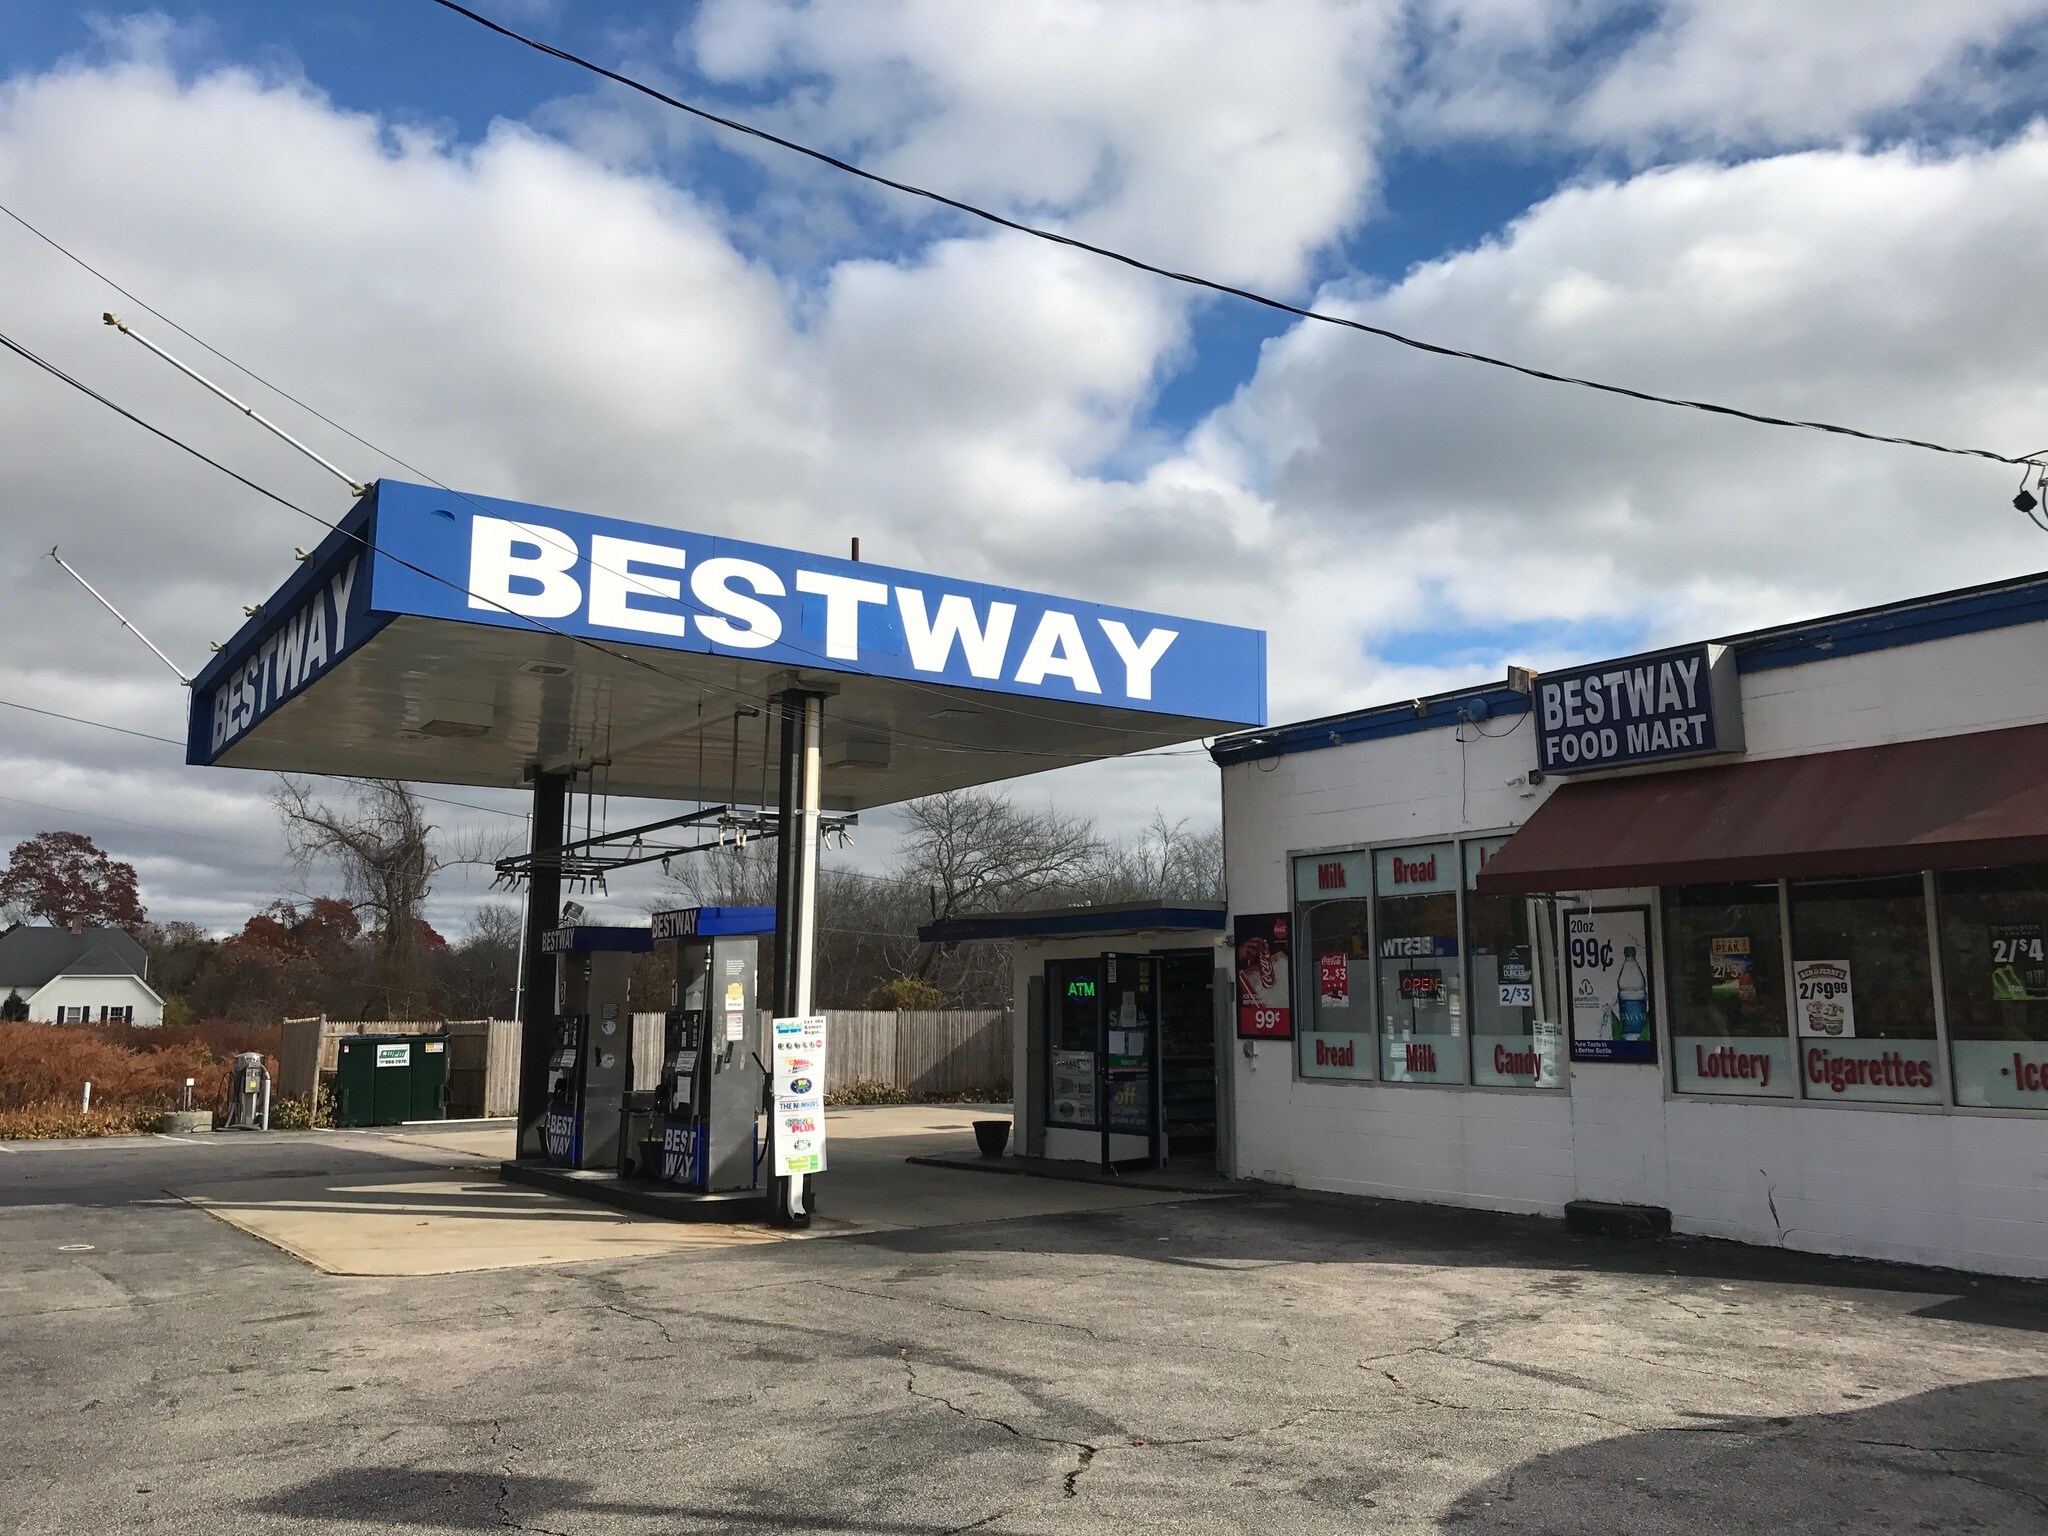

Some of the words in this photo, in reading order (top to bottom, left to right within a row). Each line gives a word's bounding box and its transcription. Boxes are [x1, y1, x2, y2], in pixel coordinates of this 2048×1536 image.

[467, 513, 1180, 702] BESTWAY
[211, 554, 359, 754] BESTWAY
[1542, 656, 1700, 731] BESTWAY
[1546, 728, 1618, 765] FOOD
[1626, 713, 1707, 754] MART
[1318, 862, 1345, 890] Milk
[1393, 854, 1436, 885] Bread
[651, 909, 698, 939] BESTWAY
[1571, 920, 1594, 932] 20oz
[541, 927, 575, 951] BESTWAY
[1715, 944, 1740, 952] PEAK
[1992, 939, 2044, 962] 2/$4
[1571, 937, 1614, 971] 99¢
[1322, 968, 1329, 980] 2
[1335, 968, 1347, 980] $3
[1713, 964, 1739, 978] 2/$3
[1067, 981, 1095, 996] ATM
[1402, 977, 1439, 992] OPEN
[1501, 986, 1530, 1004] 2/$3
[1255, 1010, 1281, 1029] 99¢
[1315, 1039, 1354, 1068] Bread
[1405, 1044, 1437, 1073] Milk
[1494, 1043, 1541, 1082] Candy
[1695, 1044, 1770, 1087] Lottery
[1808, 1047, 1933, 1093] Cigarettes
[780, 1102, 792, 1110] THE
[793, 1101, 819, 1110] NUMBERS
[550, 1114, 573, 1136] BEST
[792, 1122, 815, 1133] PLUS
[550, 1135, 571, 1156] WAY
[664, 1128, 697, 1152] BEST
[664, 1152, 694, 1178] WAY
